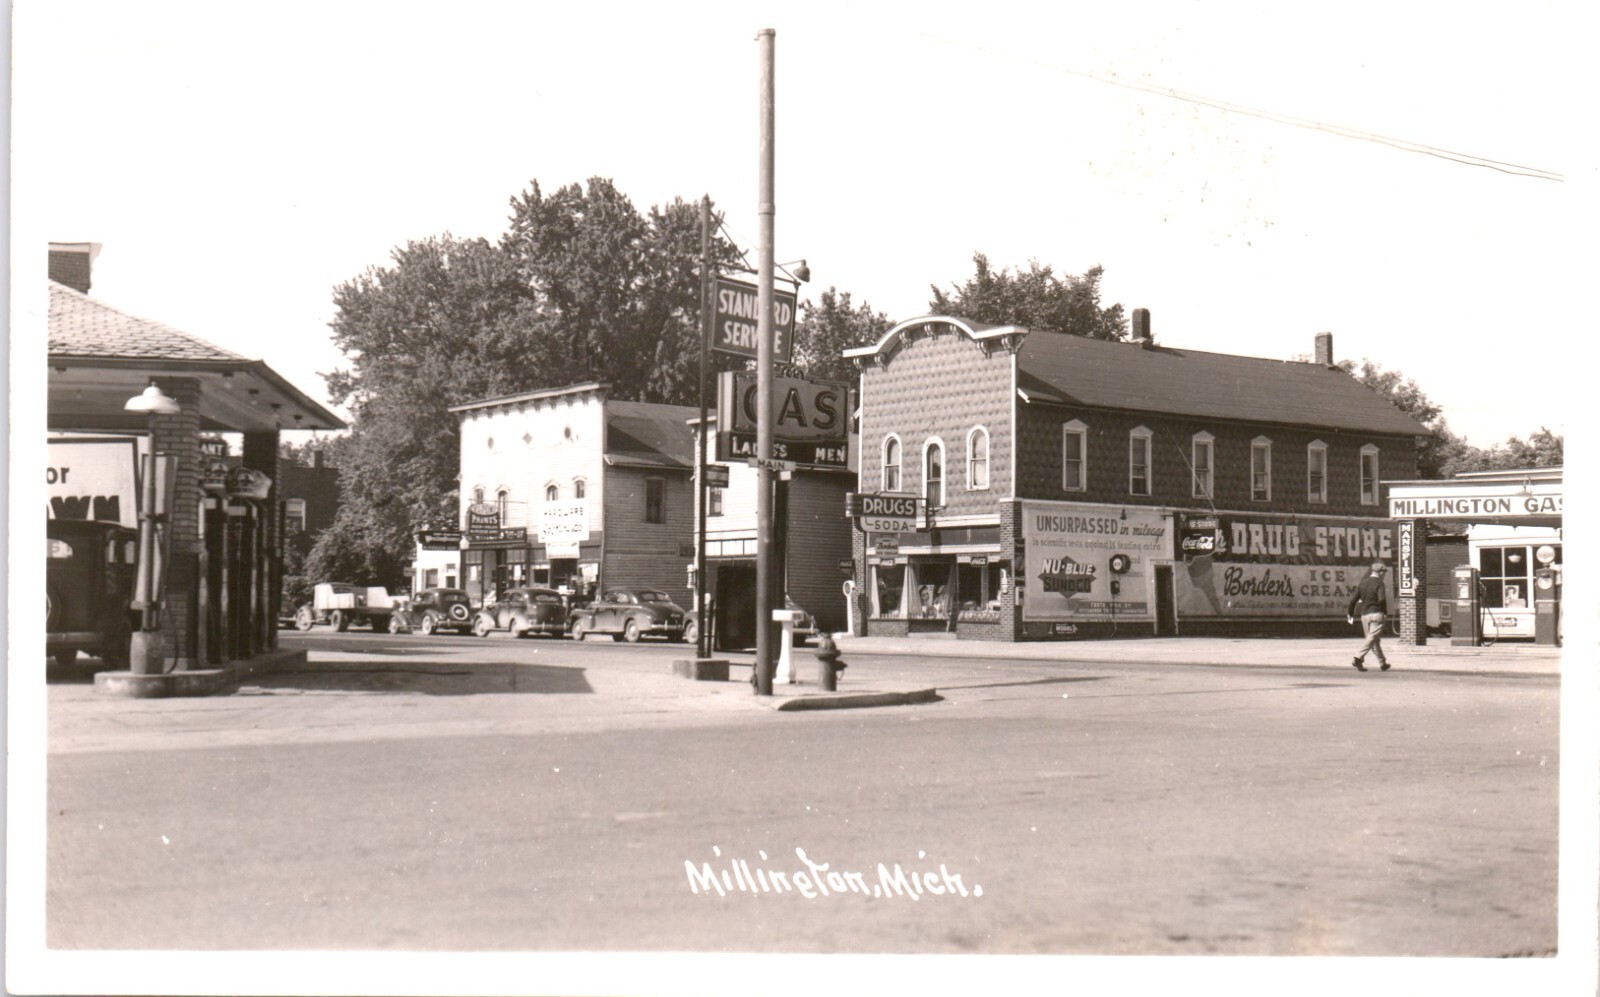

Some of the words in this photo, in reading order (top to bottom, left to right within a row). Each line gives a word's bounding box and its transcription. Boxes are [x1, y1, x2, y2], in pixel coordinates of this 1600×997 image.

[718, 289, 791, 326] STANDRD
[723, 320, 783, 354] SERVE
[732, 436, 788, 458] LADS
[814, 444, 846, 464] MEN
[757, 459, 785, 469] MAIN
[47, 495, 121, 523] WN
[863, 498, 914, 515] DRUGS
[1393, 498, 1511, 515] MILLINGTON
[471, 515, 498, 525] PAINTS
[875, 520, 908, 531] SODA
[1036, 515, 1118, 535] UNSURPASSED
[1119, 522, 1129, 536] in
[1132, 523, 1165, 543] mileage
[1231, 523, 1300, 556] DRUG
[1315, 526, 1392, 559] STORE
[1401, 524, 1411, 588] MANSFIELD
[1044, 576, 1091, 592] SUNOCO
[1224, 566, 1295, 598] Borden's
[1309, 569, 1346, 582] ICE
[1302, 584, 1358, 598] CREAM
